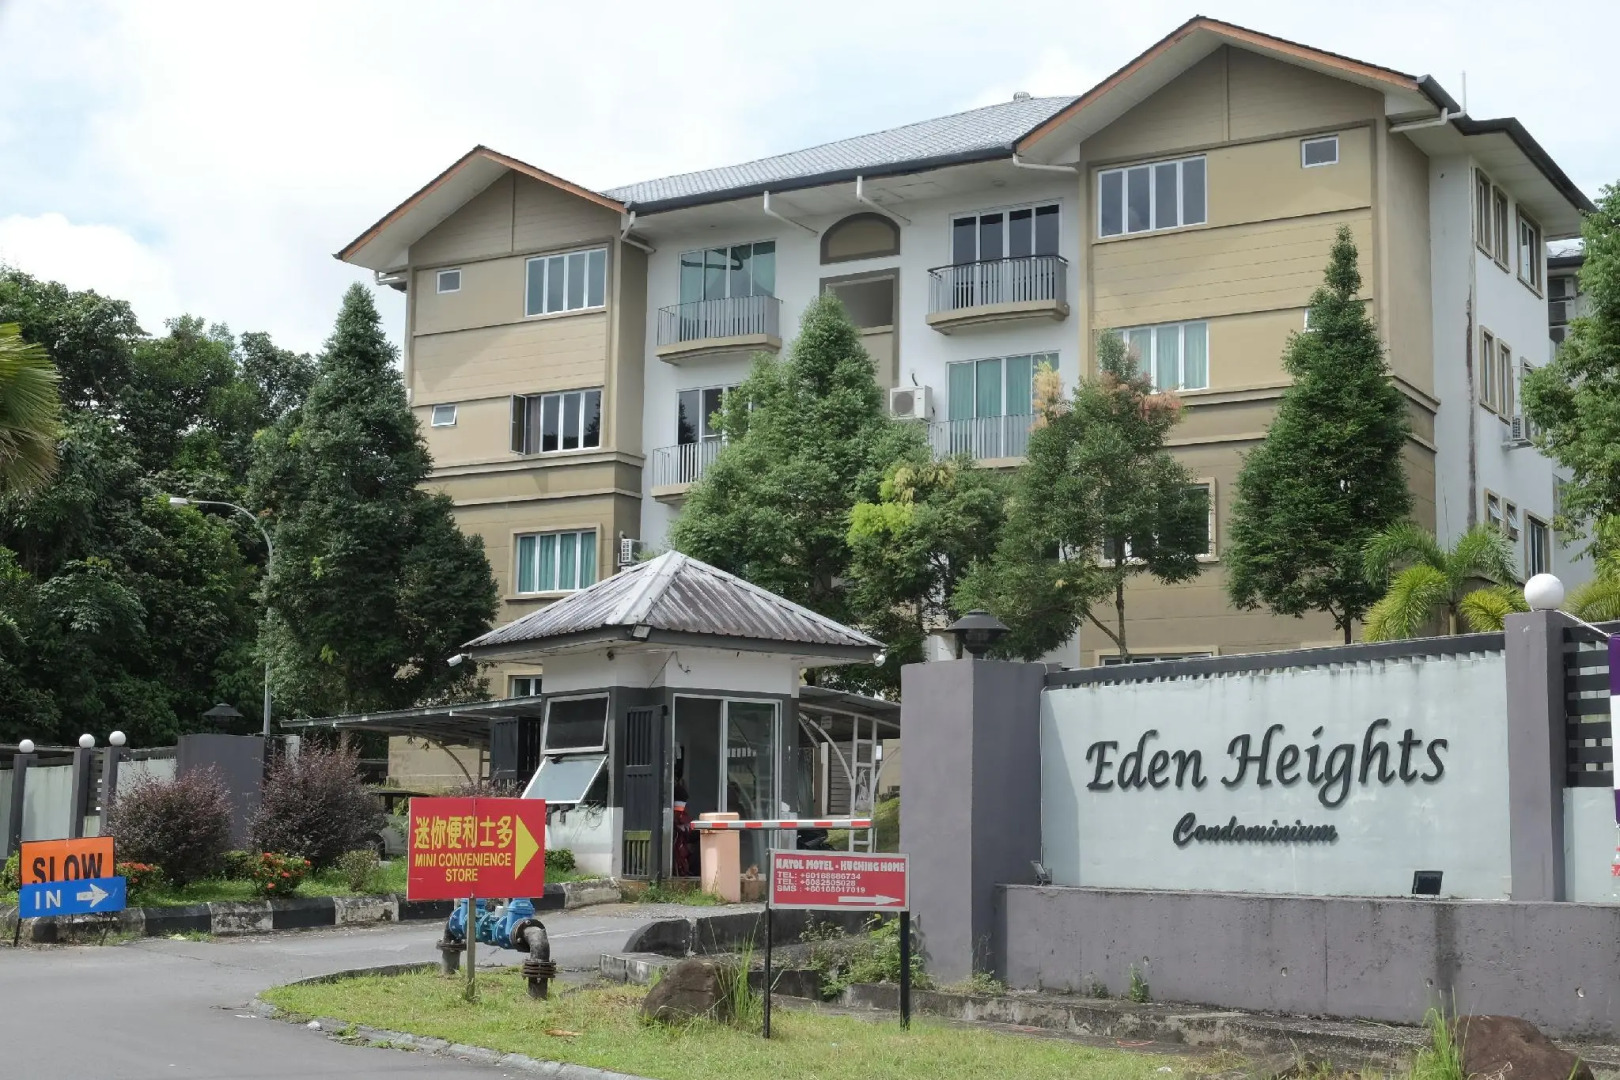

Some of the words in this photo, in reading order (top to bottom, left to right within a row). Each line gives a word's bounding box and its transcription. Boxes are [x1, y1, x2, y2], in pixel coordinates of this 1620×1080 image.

[1085, 729, 1207, 790] Eden
[1220, 718, 1448, 808] Heights
[414, 815, 513, 850] 迷你便利士多
[1173, 812, 1339, 847] Condominium
[32, 852, 103, 884] SLOW
[415, 853, 437, 867] MINI
[438, 852, 511, 867] CONVENIENCE
[806, 860, 834, 871] MOTEL
[880, 861, 905, 872] HOME
[445, 868, 478, 882] STORE
[777, 871, 797, 879] TEL:
[777, 878, 798, 886] TEL:
[35, 890, 61, 910] IN
